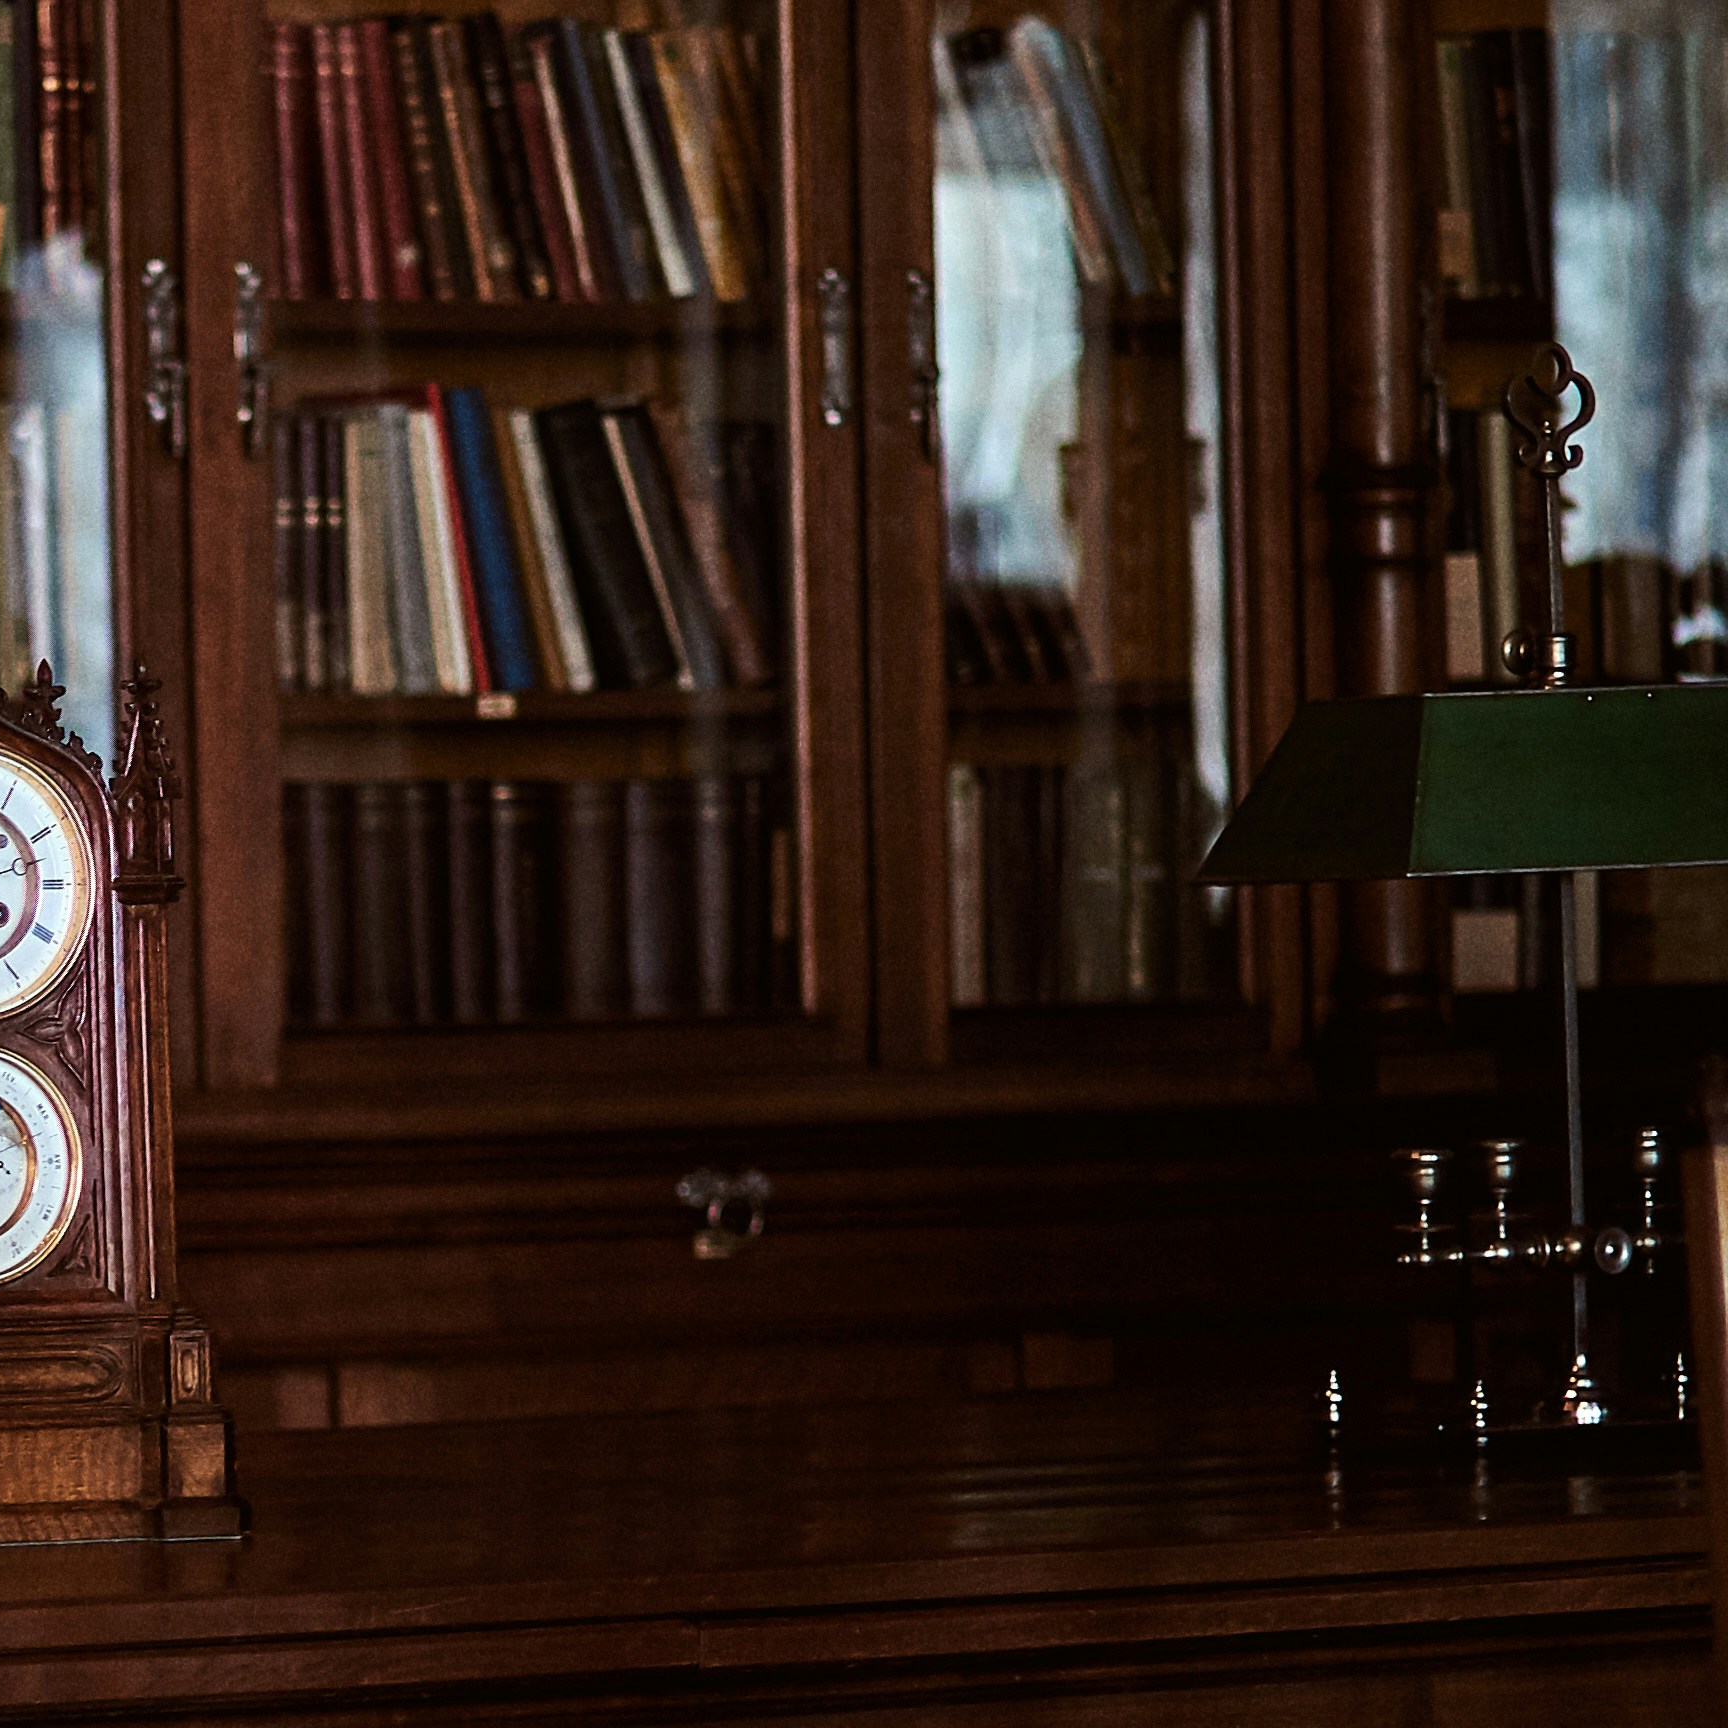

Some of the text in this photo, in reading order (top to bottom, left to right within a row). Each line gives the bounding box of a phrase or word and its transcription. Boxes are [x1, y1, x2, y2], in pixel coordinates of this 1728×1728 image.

[0, 787, 14, 810] I
[30, 826, 52, 844] II
[42, 879, 64, 890] III
[32, 922, 55, 944] IIII
